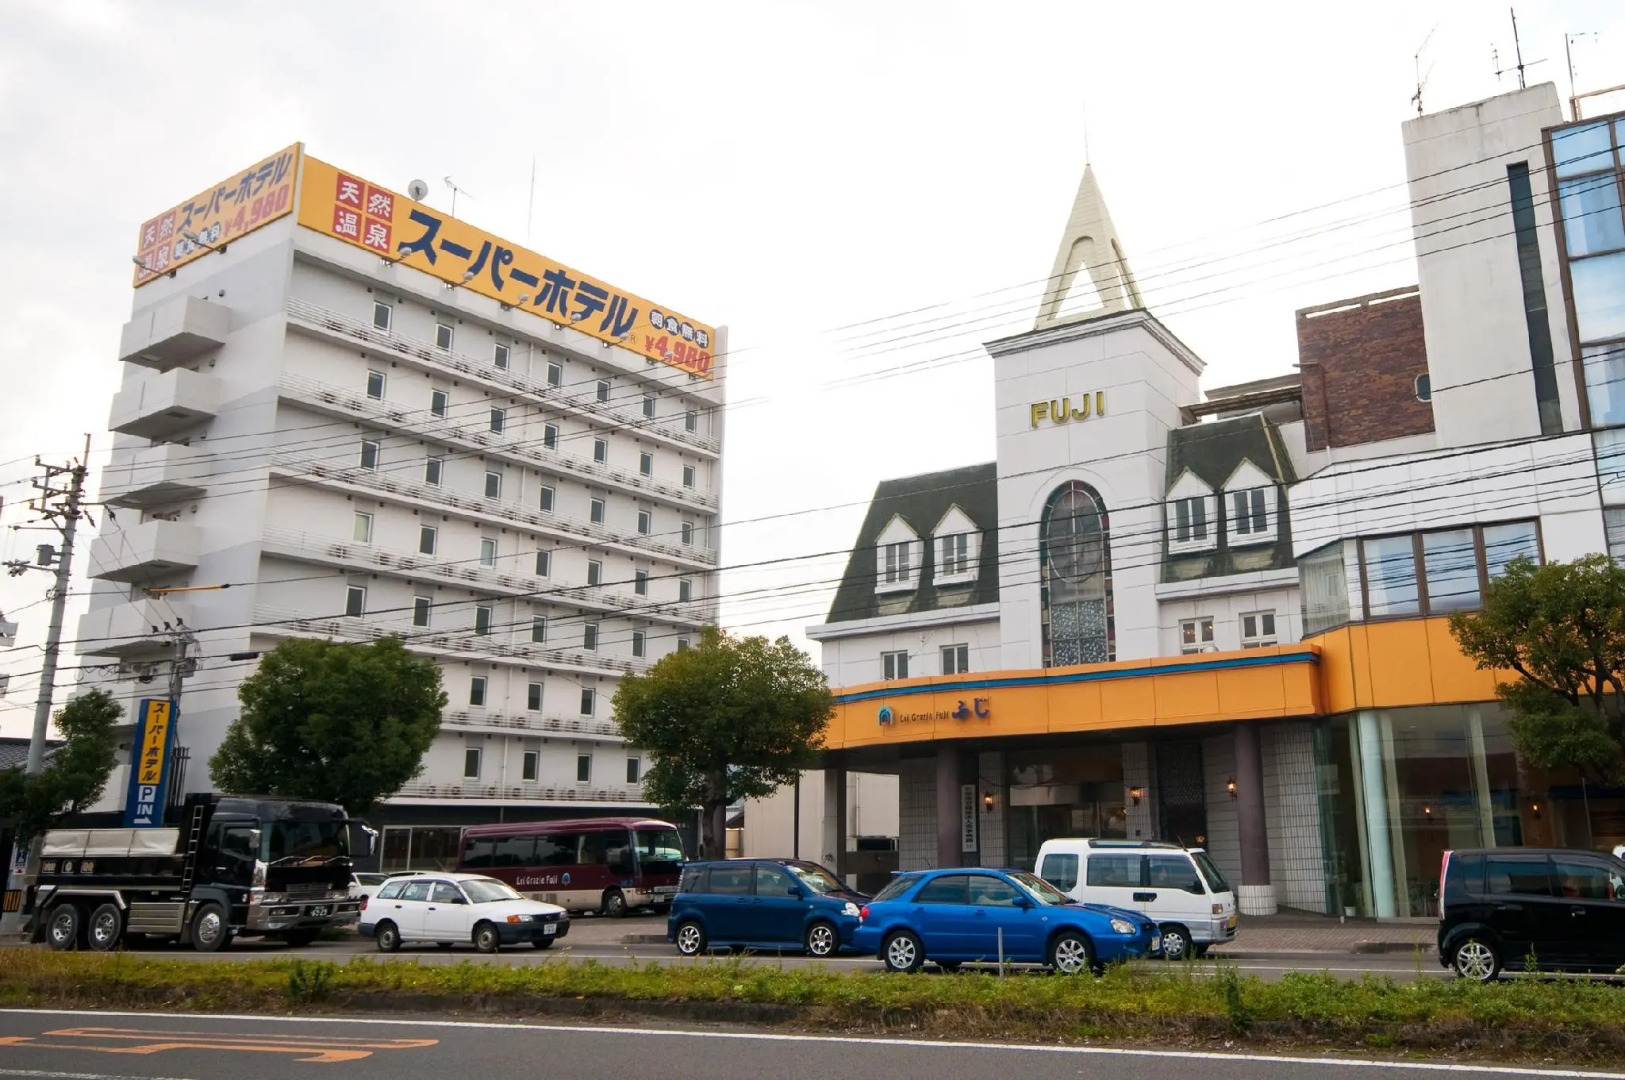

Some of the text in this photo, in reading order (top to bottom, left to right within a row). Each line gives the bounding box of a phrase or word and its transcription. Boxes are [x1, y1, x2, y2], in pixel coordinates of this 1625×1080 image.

[176, 152, 294, 235] スーパーホテル
[338, 180, 392, 218] 天然
[334, 210, 389, 250] 温泉
[397, 208, 639, 338] スーパーホテル
[649, 309, 709, 350] 朝食無料
[1031, 391, 1105, 429] FUJI
[951, 697, 991, 720] ふじ
[141, 703, 166, 782] スーパーホテル
[136, 804, 153, 815] IN
[141, 786, 153, 801] P
